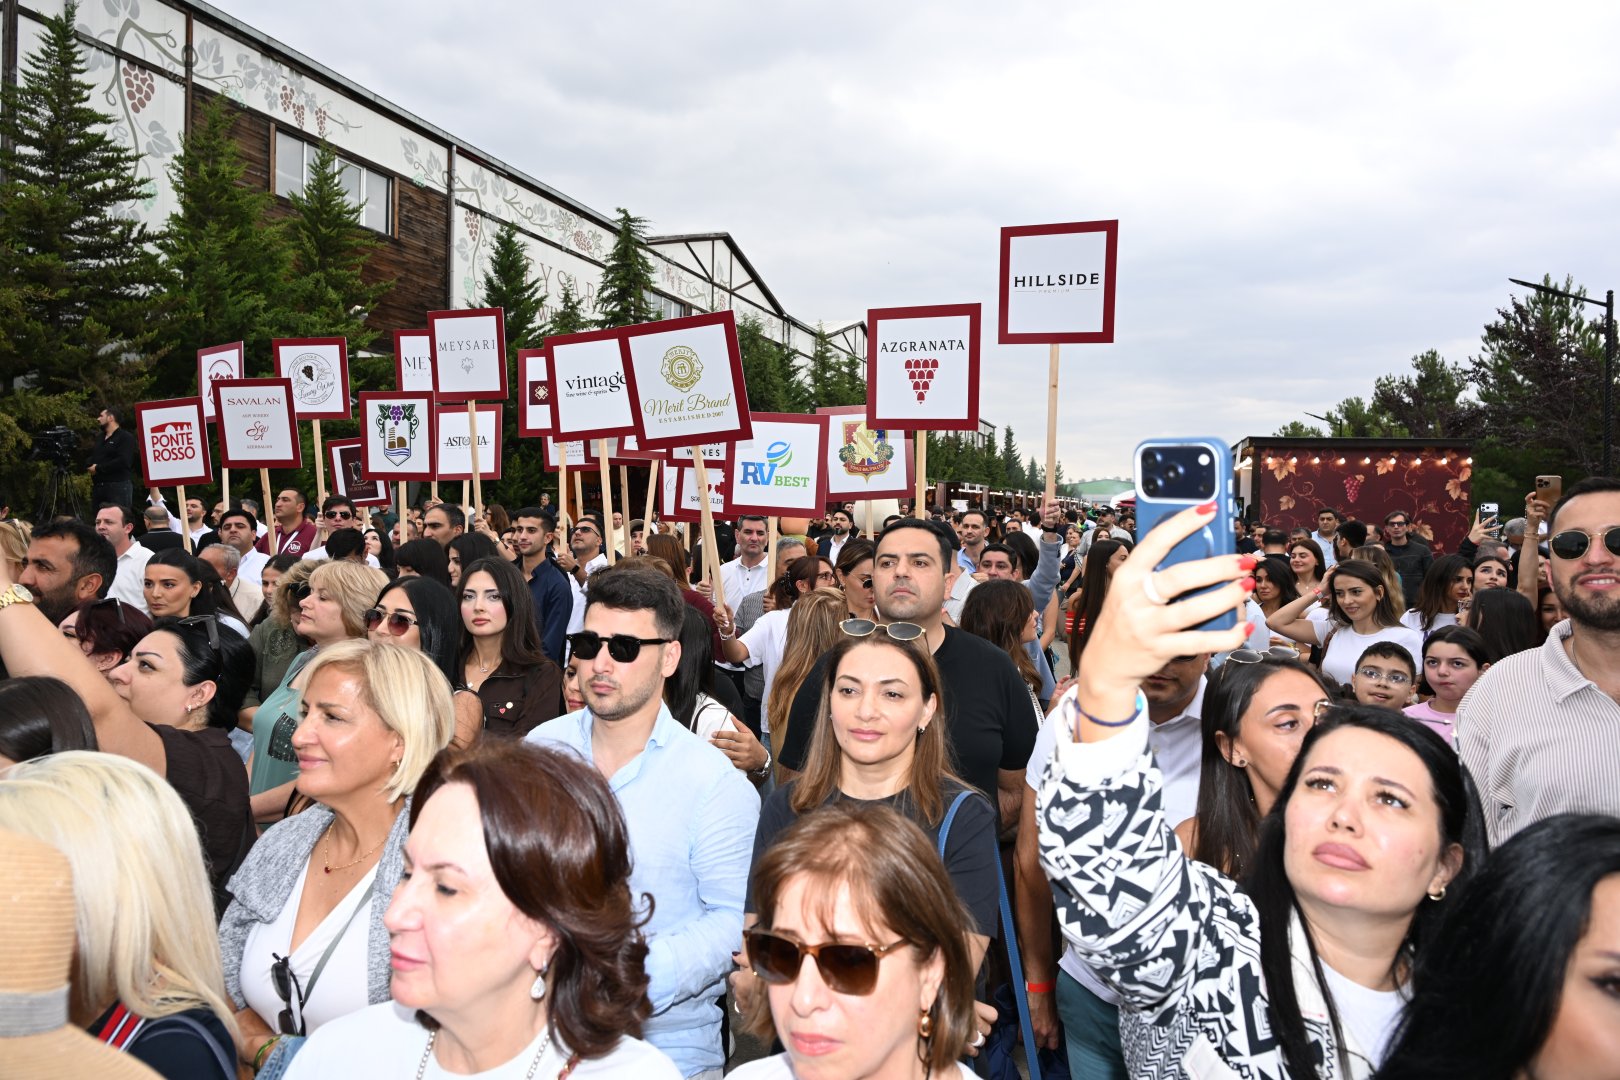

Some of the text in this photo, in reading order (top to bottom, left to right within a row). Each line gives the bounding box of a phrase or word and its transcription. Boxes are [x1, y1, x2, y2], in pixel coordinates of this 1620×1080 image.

[1014, 273, 1099, 288] HILLSIDE
[438, 339, 496, 352] MEYSARI
[880, 339, 966, 353] AZGRANATA
[565, 371, 626, 393] vintage
[593, 389, 608, 397] spirits
[227, 397, 281, 406] SAVALAN
[643, 393, 731, 417] Merit Brand
[658, 410, 724, 424] ESTABLISHED 2007
[151, 432, 194, 449] PONTE
[445, 435, 488, 447] ASTOIA
[153, 446, 196, 462] ROSSO
[686, 448, 720, 457] WNES
[740, 461, 810, 488] RV BEST
